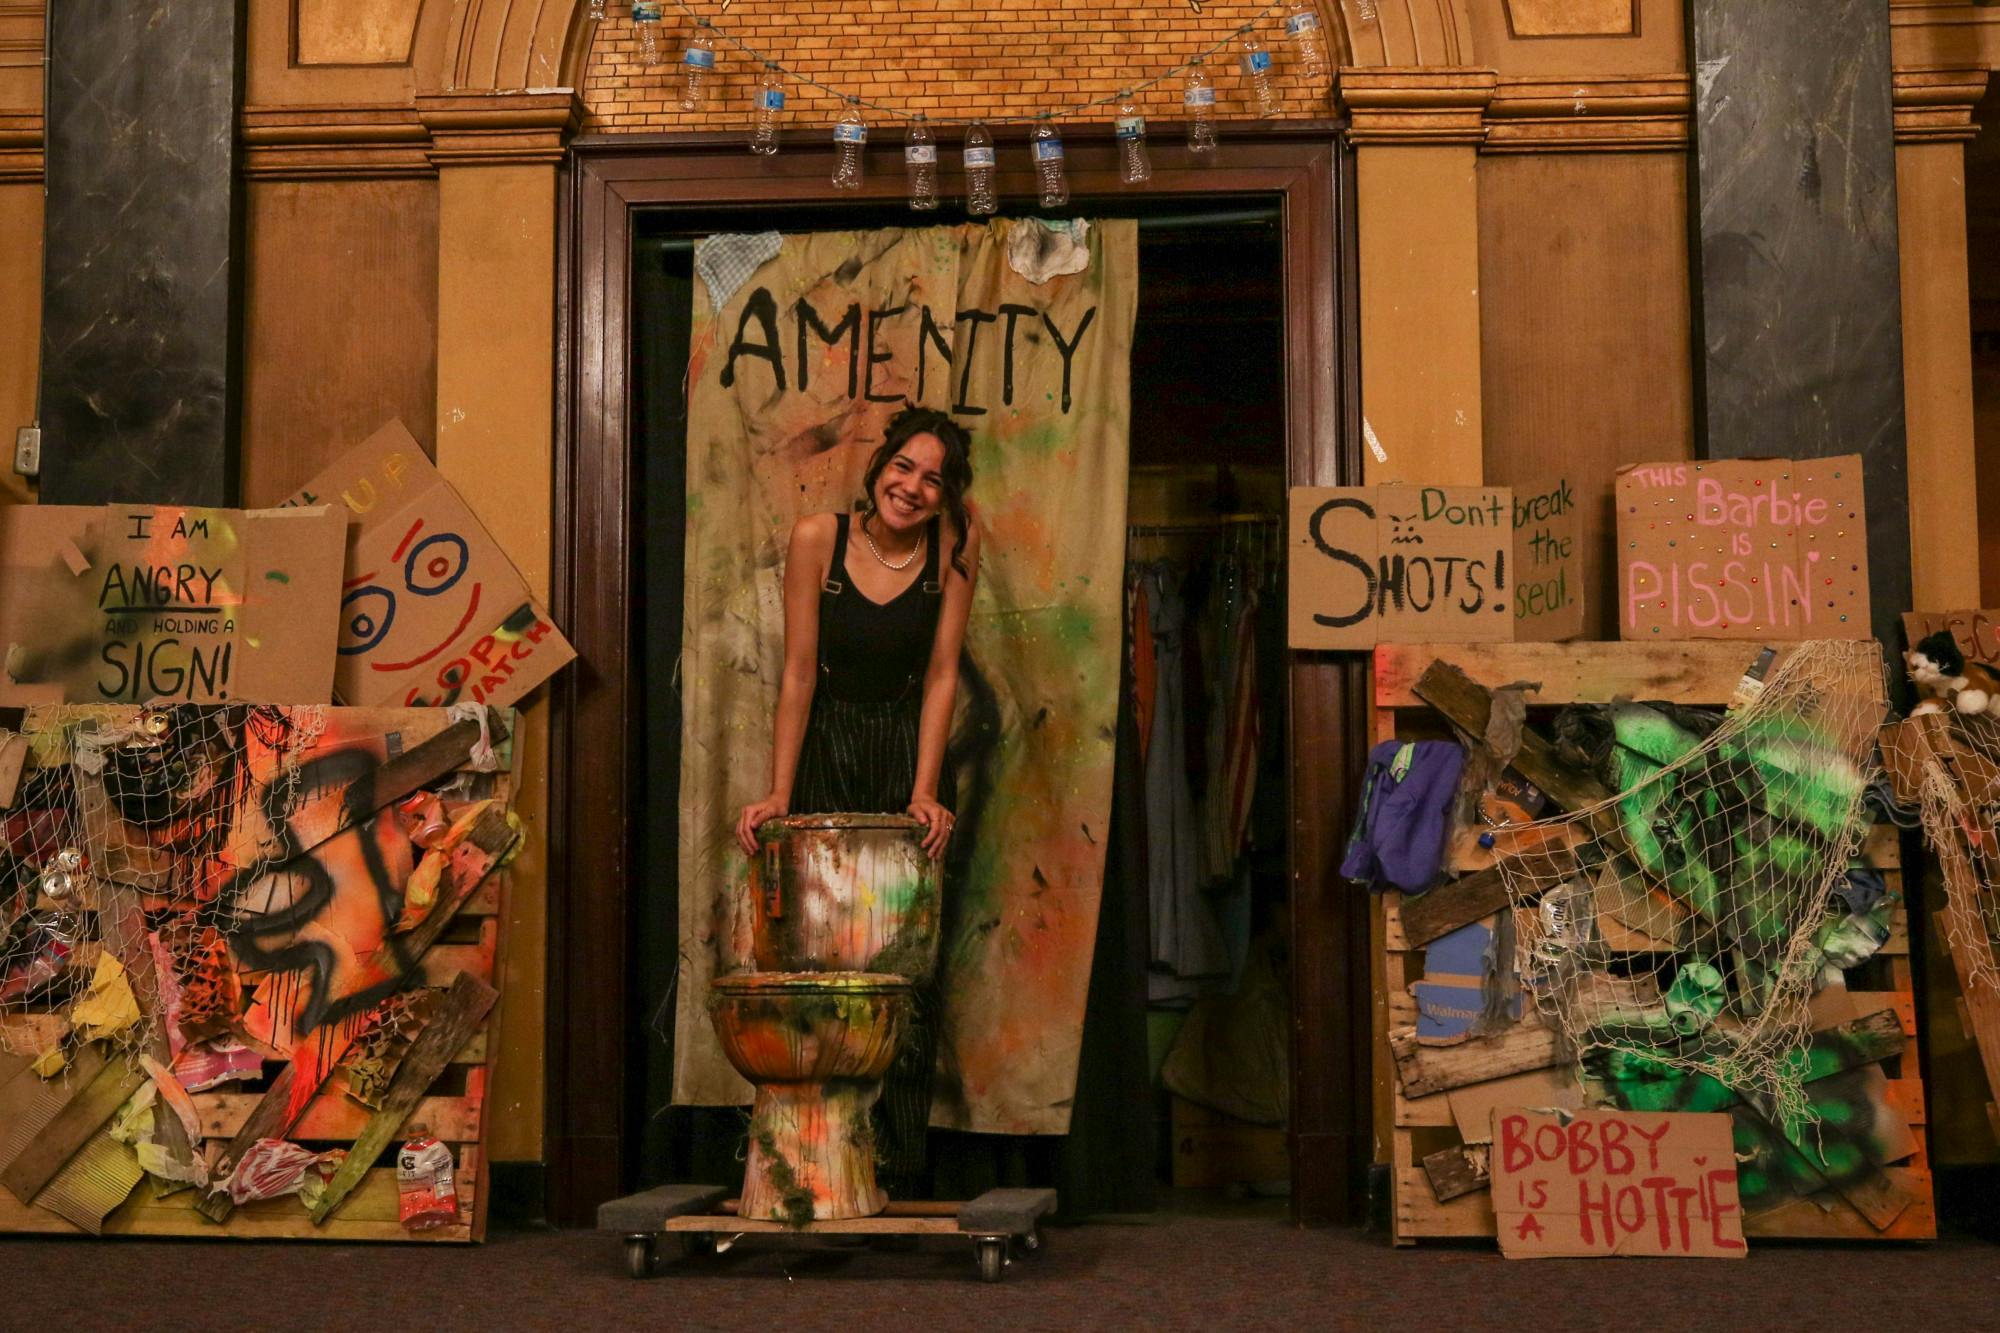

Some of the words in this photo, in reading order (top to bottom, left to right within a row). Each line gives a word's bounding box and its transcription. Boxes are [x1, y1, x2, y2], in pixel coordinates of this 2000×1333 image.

[720, 287, 1096, 415] AMENITY
[1632, 466, 1689, 490] THIS
[1421, 487, 1504, 526] Don't
[1512, 479, 1575, 531] break
[1697, 478, 1831, 530] Barbie
[128, 514, 153, 540] I
[170, 516, 209, 539] AM
[1528, 528, 1573, 564] the
[1732, 532, 1752, 556] IS
[1308, 498, 1506, 629] SHOTS!
[99, 563, 223, 608] ANGRY
[105, 620, 138, 635] AND
[154, 618, 219, 635] HOLDING
[222, 619, 235, 634] A
[97, 639, 232, 700] SIGN!
[1426, 1003, 1480, 1021] Walmar
[1501, 1115, 1670, 1176] BOBBY
[1518, 1180, 1549, 1209] IS
[1578, 1157, 1745, 1251] HOTTIE
[1514, 1214, 1546, 1241] A
